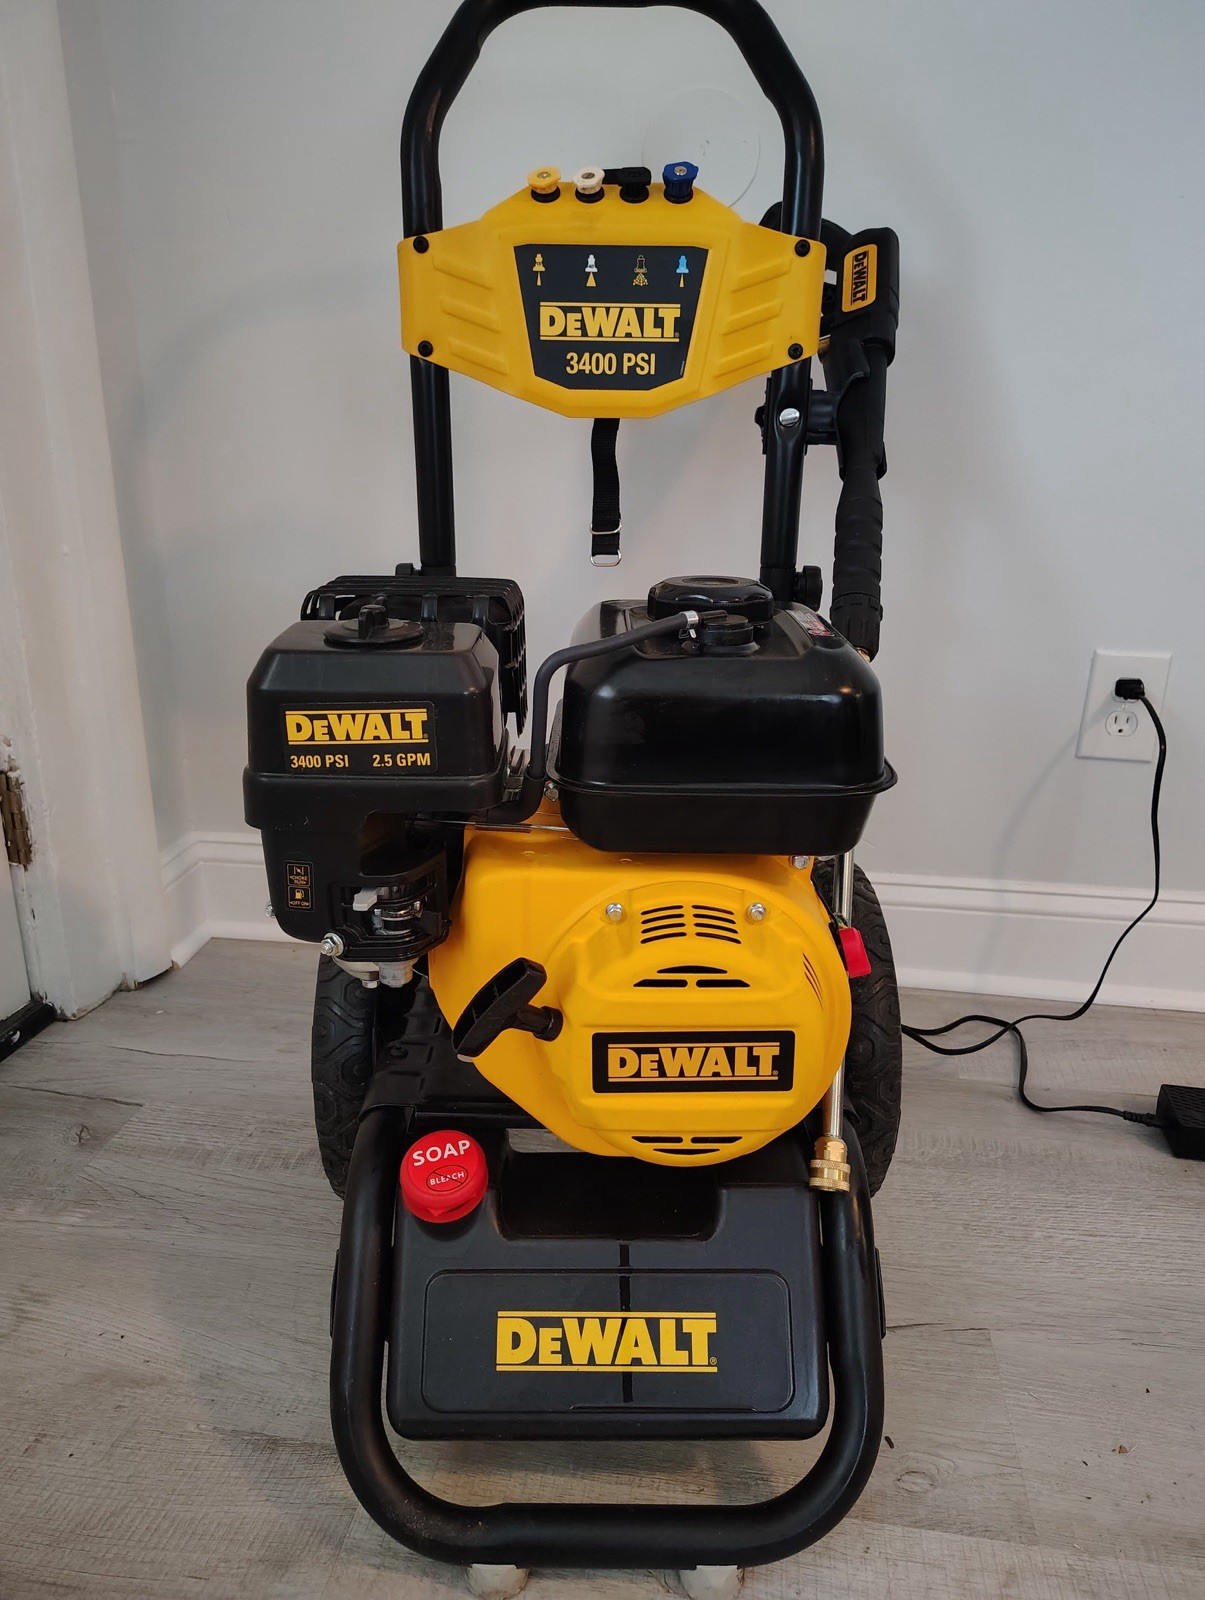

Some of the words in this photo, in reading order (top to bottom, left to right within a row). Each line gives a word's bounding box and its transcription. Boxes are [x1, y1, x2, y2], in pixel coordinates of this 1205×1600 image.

[565, 352, 617, 375] 3400
[623, 353, 656, 375] PSI
[290, 754, 322, 769] 3400
[325, 754, 349, 768] PSI
[372, 753, 393, 767] 2.5
[396, 753, 431, 767] GPM
[412, 1139, 471, 1167] SOAP
